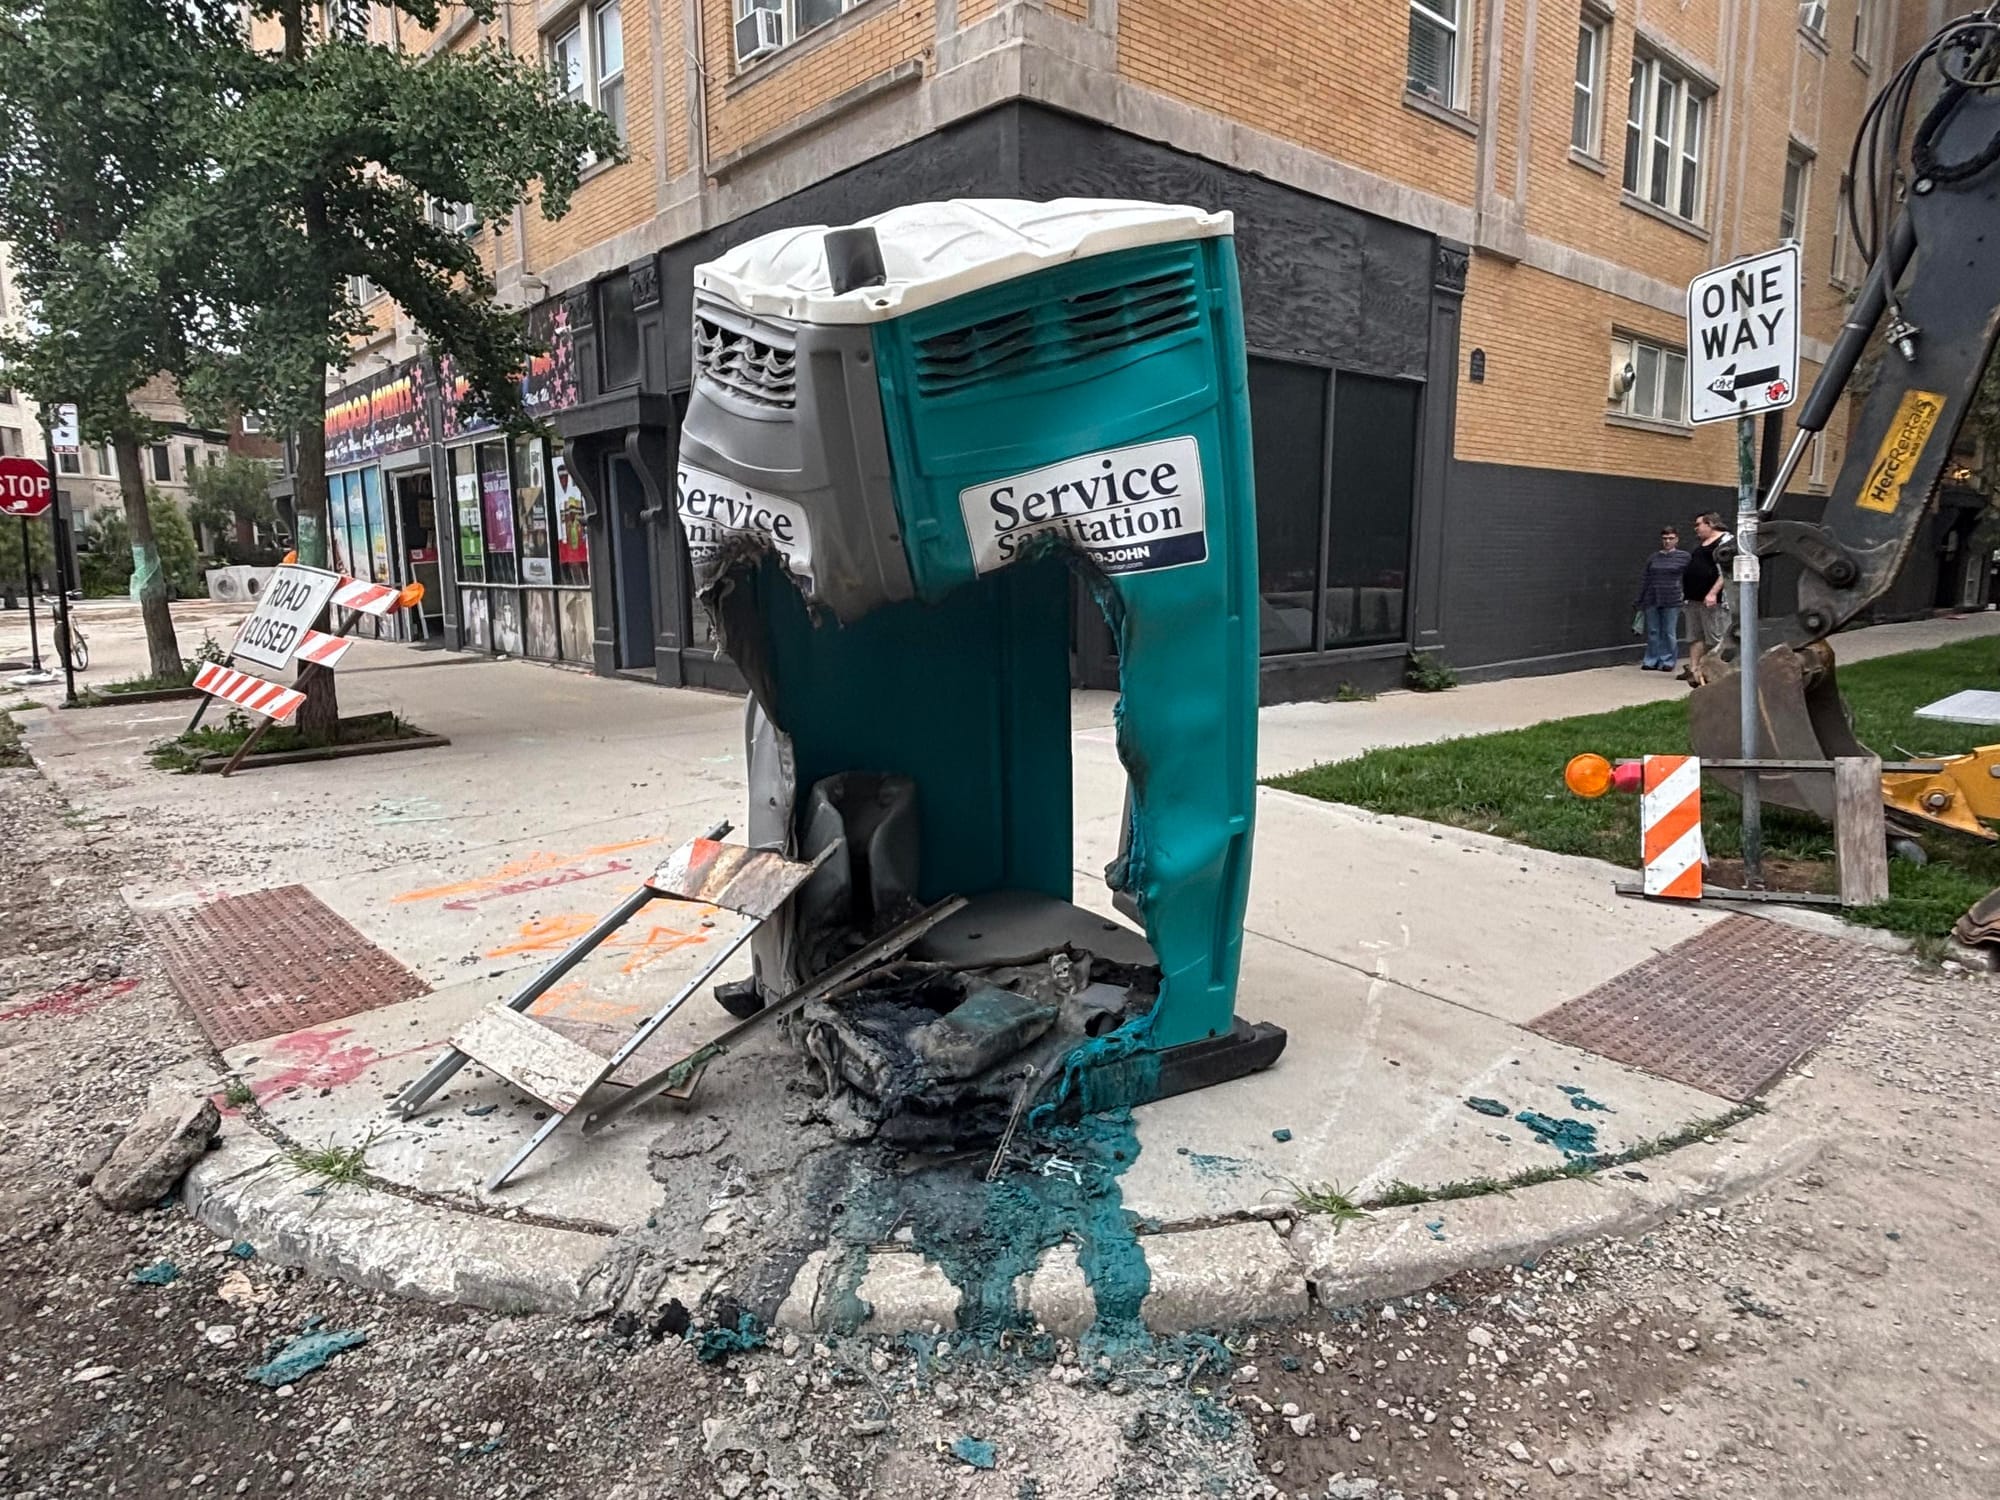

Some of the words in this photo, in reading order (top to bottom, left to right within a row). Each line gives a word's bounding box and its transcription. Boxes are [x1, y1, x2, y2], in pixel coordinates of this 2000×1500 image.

[1702, 265, 1784, 318] ONE
[1701, 307, 1785, 360] WAY
[677, 471, 794, 541] Service
[990, 459, 1179, 532] Service
[266, 579, 311, 611] ROAD
[243, 616, 297, 654] CLOSED
